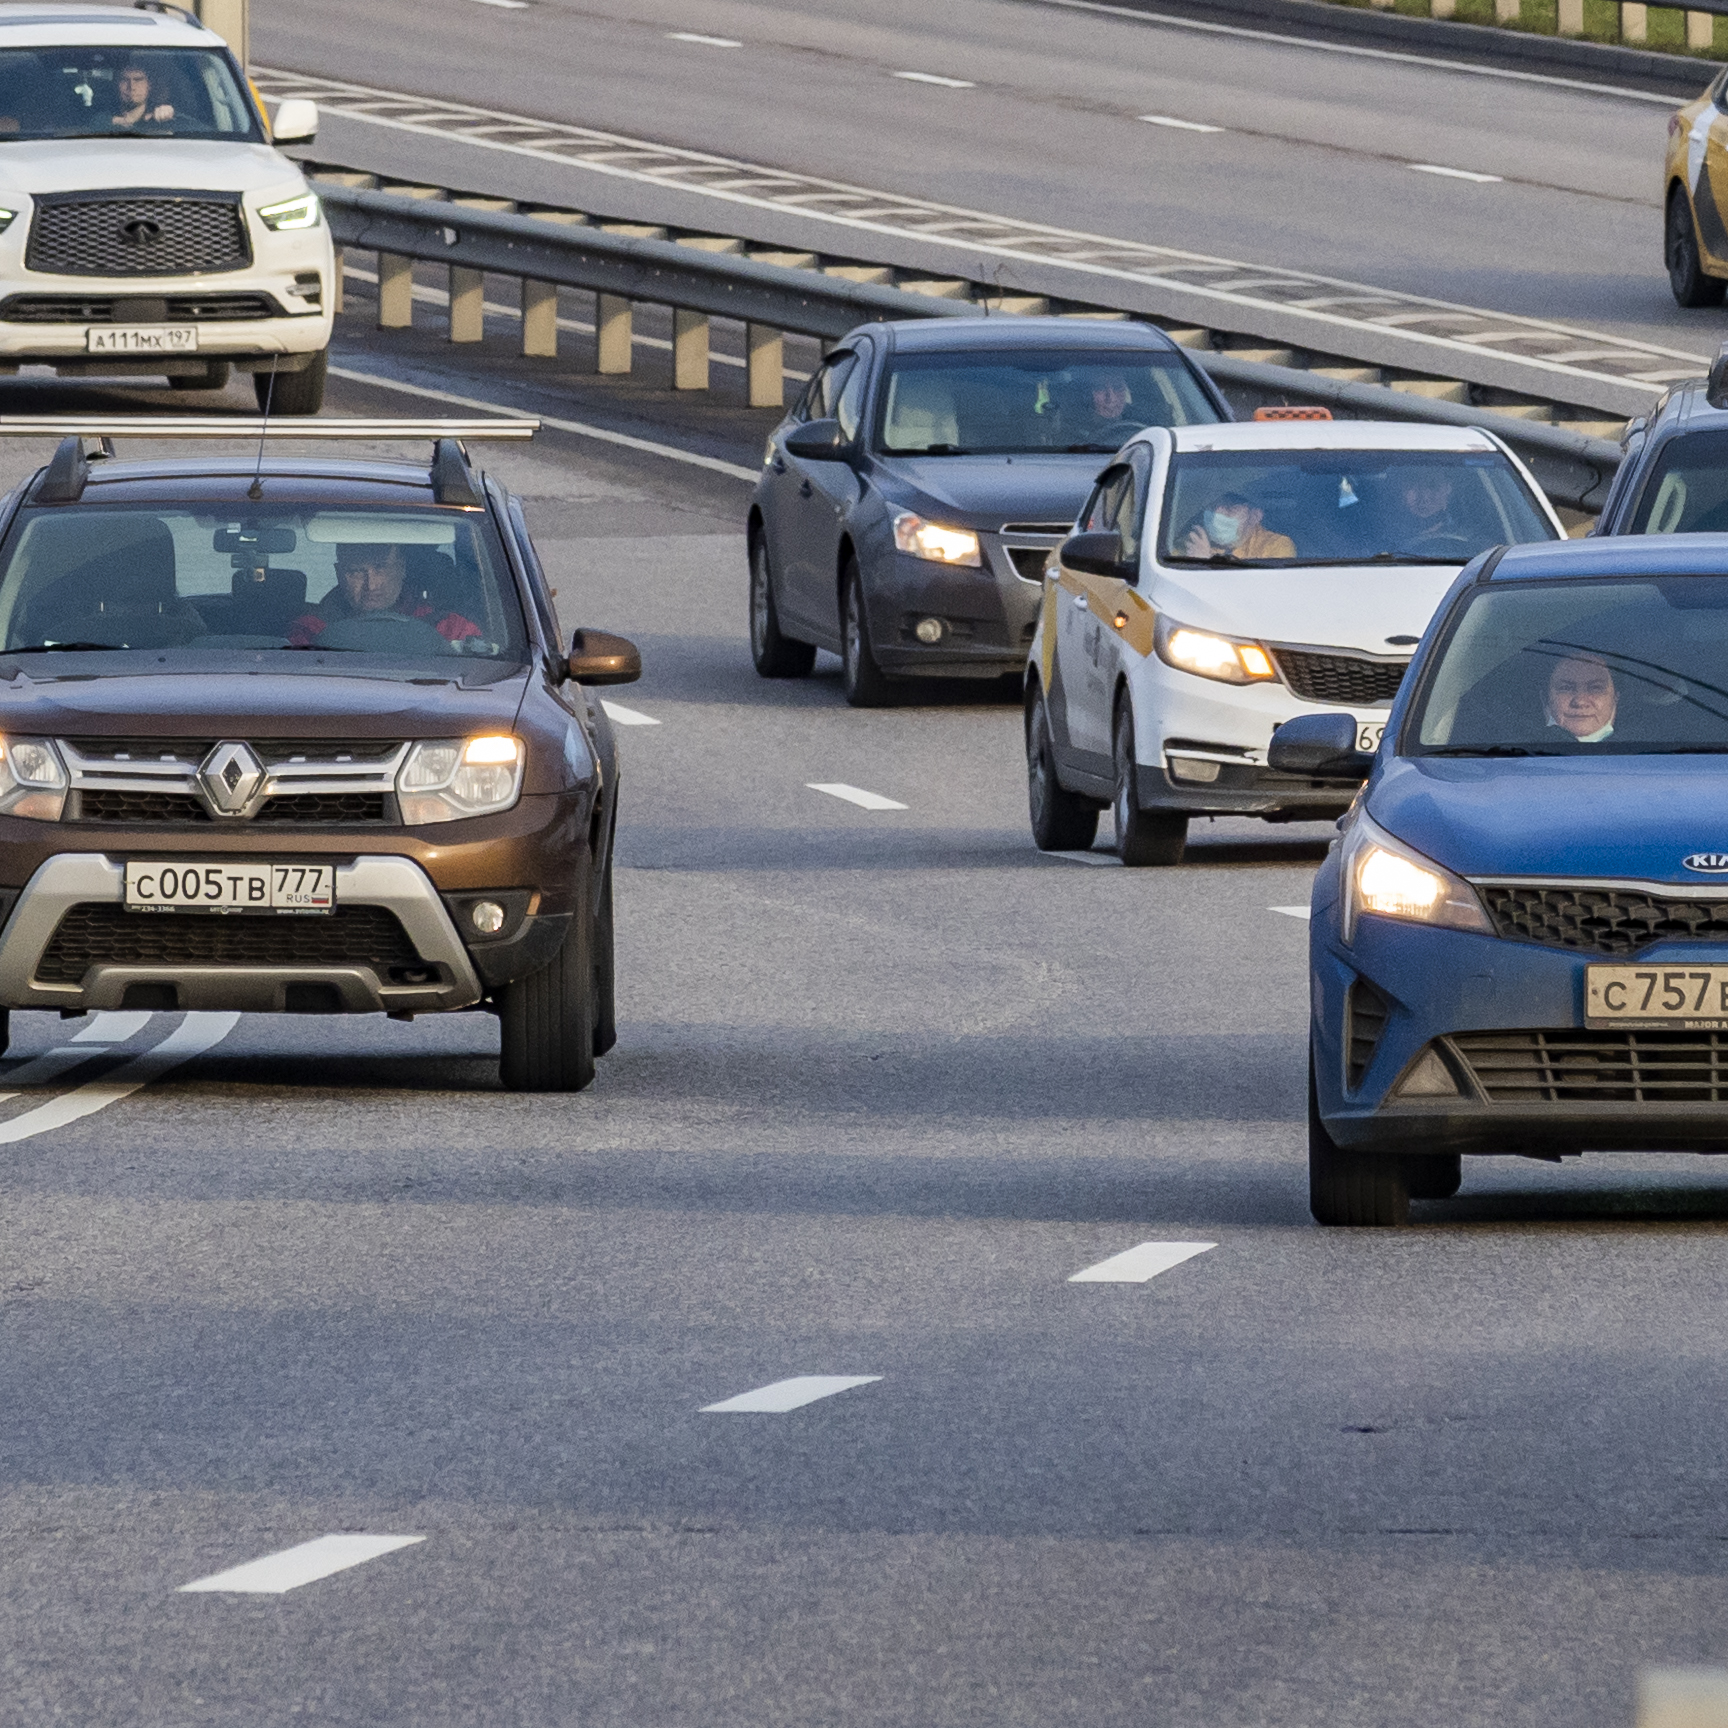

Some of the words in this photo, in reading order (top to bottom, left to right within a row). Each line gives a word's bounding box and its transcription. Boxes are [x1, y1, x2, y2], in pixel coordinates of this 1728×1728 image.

[95, 332, 162, 348] А111МХ
[168, 330, 191, 343] 197
[136, 868, 266, 901] С005ТВ
[275, 868, 323, 893] 777
[286, 893, 310, 903] RUS
[1684, 1021, 1719, 1029] MAJOR
